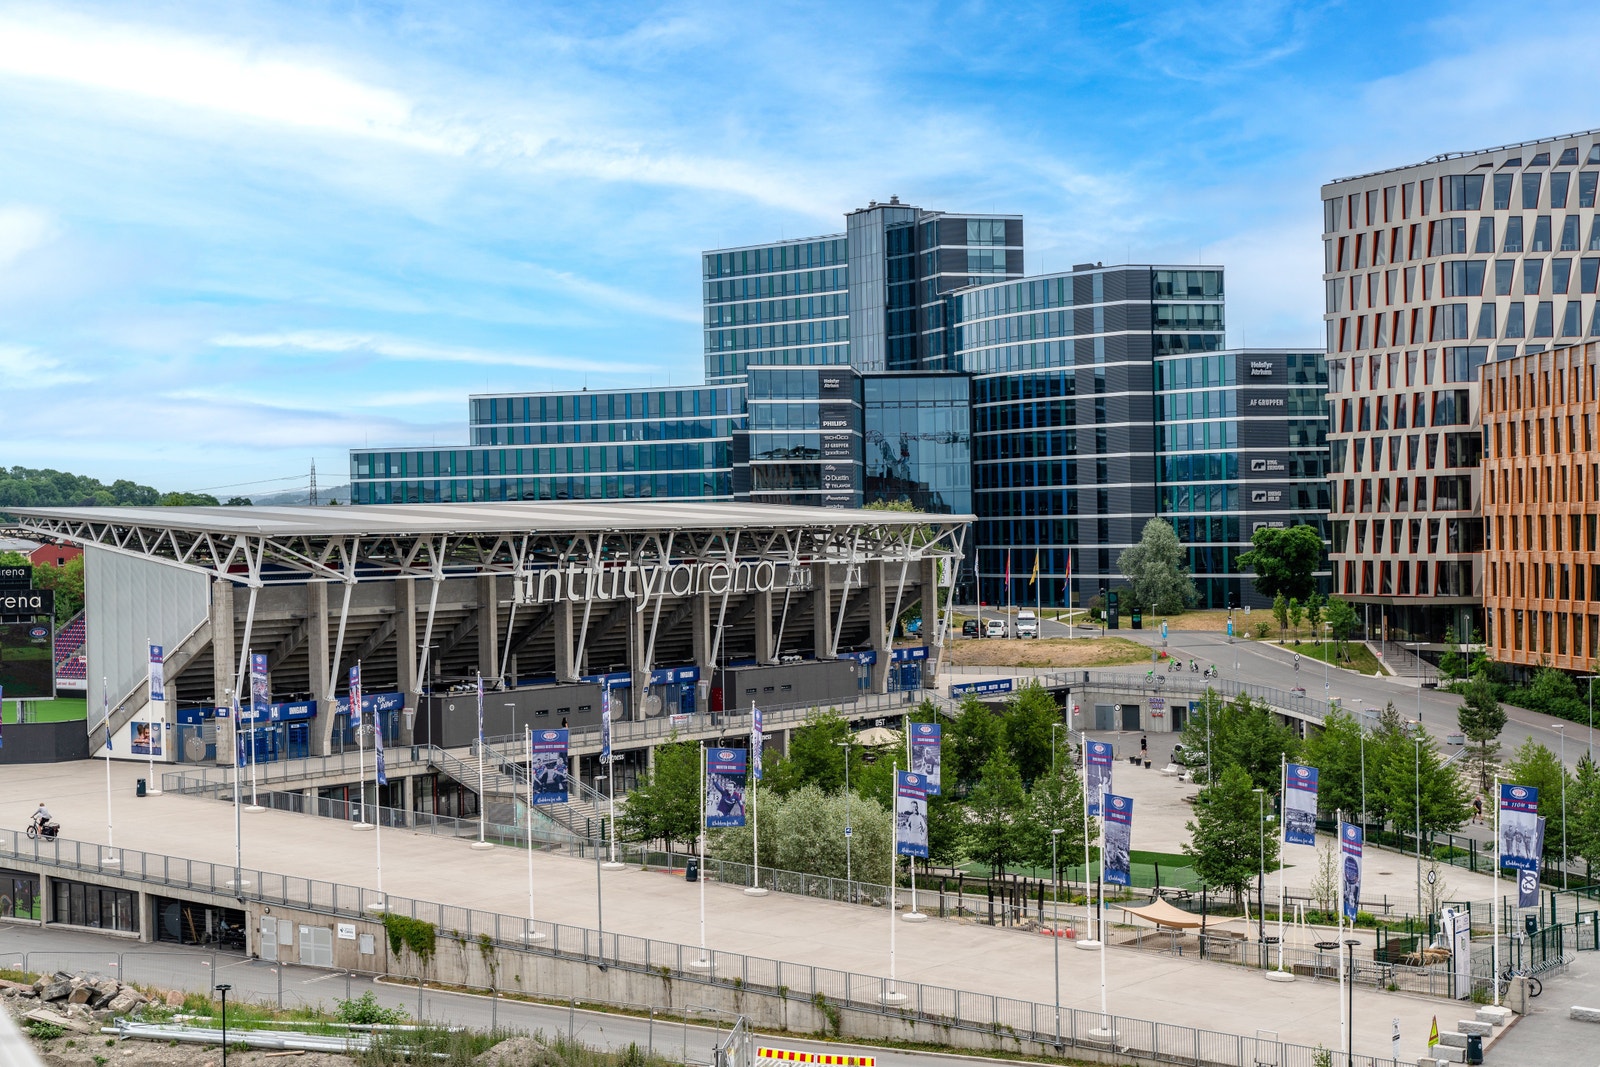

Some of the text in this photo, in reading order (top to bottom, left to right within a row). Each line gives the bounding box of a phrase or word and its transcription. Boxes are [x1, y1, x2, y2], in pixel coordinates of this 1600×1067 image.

[0, 568, 25, 577] rena
[525, 553, 776, 613] intility arena
[270, 706, 279, 718] 14
